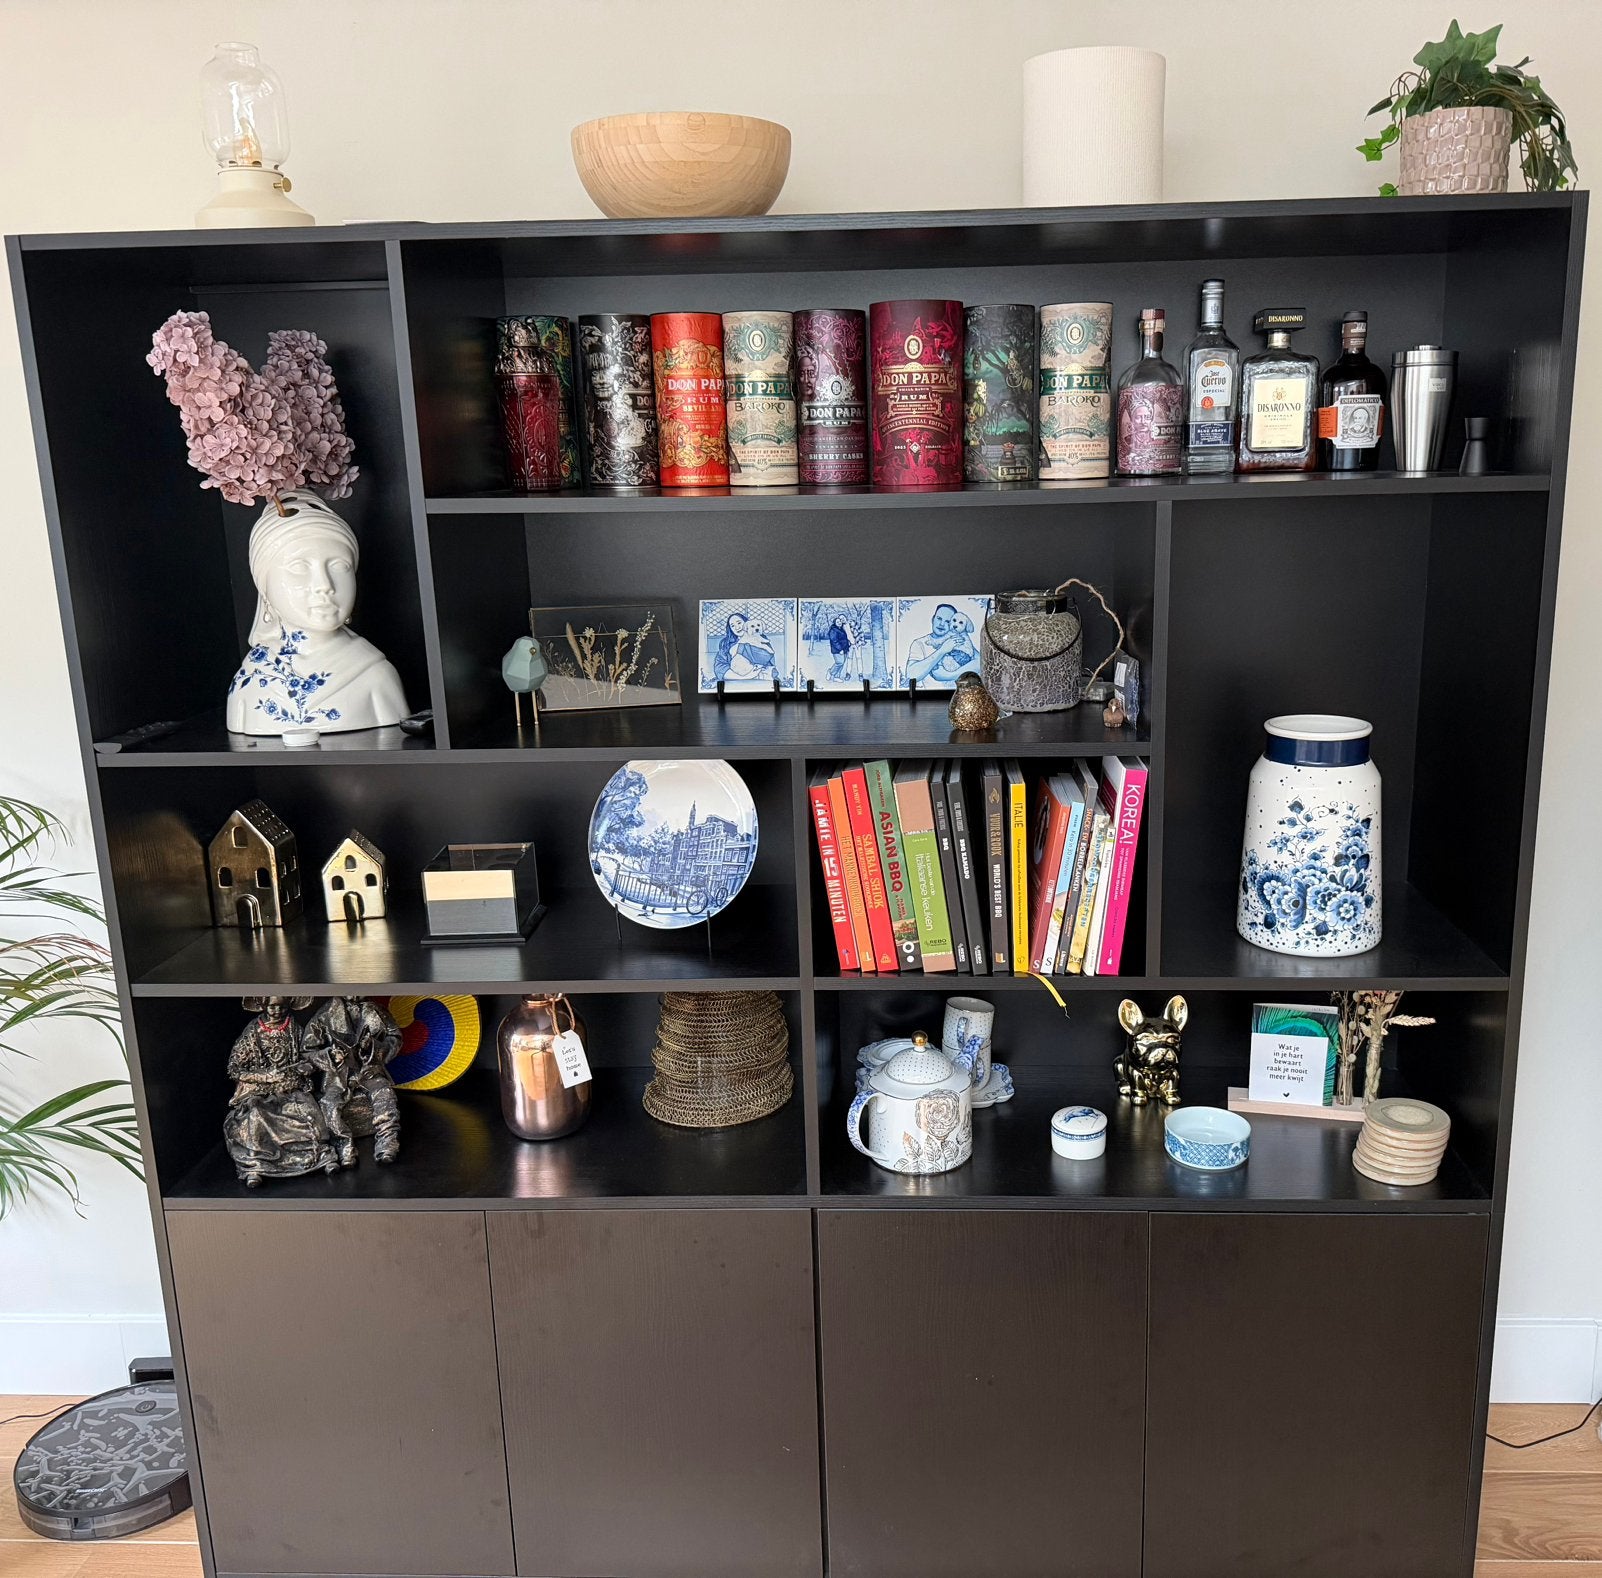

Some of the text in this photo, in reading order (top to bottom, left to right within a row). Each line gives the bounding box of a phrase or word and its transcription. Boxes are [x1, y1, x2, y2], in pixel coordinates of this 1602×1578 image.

[668, 379, 697, 390] DON
[883, 373, 946, 385] DON PAPA
[1201, 375, 1226, 387] Cuervo
[729, 382, 791, 394] DON PAPA
[735, 402, 785, 414] BAROKO
[1048, 396, 1100, 408] BAROKO
[1258, 403, 1301, 413] DISARONNO
[810, 408, 861, 418] DON PAPA
[1119, 784, 1141, 844] KOREA!
[1082, 832, 1088, 840] EN
[841, 836, 852, 850] HET
[879, 811, 904, 893] ASIAN BBQ
[814, 800, 846, 923] JAMIE IN 15 MINUTEN
[961, 852, 970, 879] KAMADO
[1072, 842, 1087, 892] BORRELPLANKEN
[862, 834, 884, 909] SAMBAL SHIOK
[993, 864, 1003, 918] WORLD'S BEST BBQ
[920, 897, 933, 931] keuken
[1274, 1058, 1302, 1066] bewaart
[1283, 1066, 1289, 1074] je
[1287, 1074, 1304, 1083] kwijt
